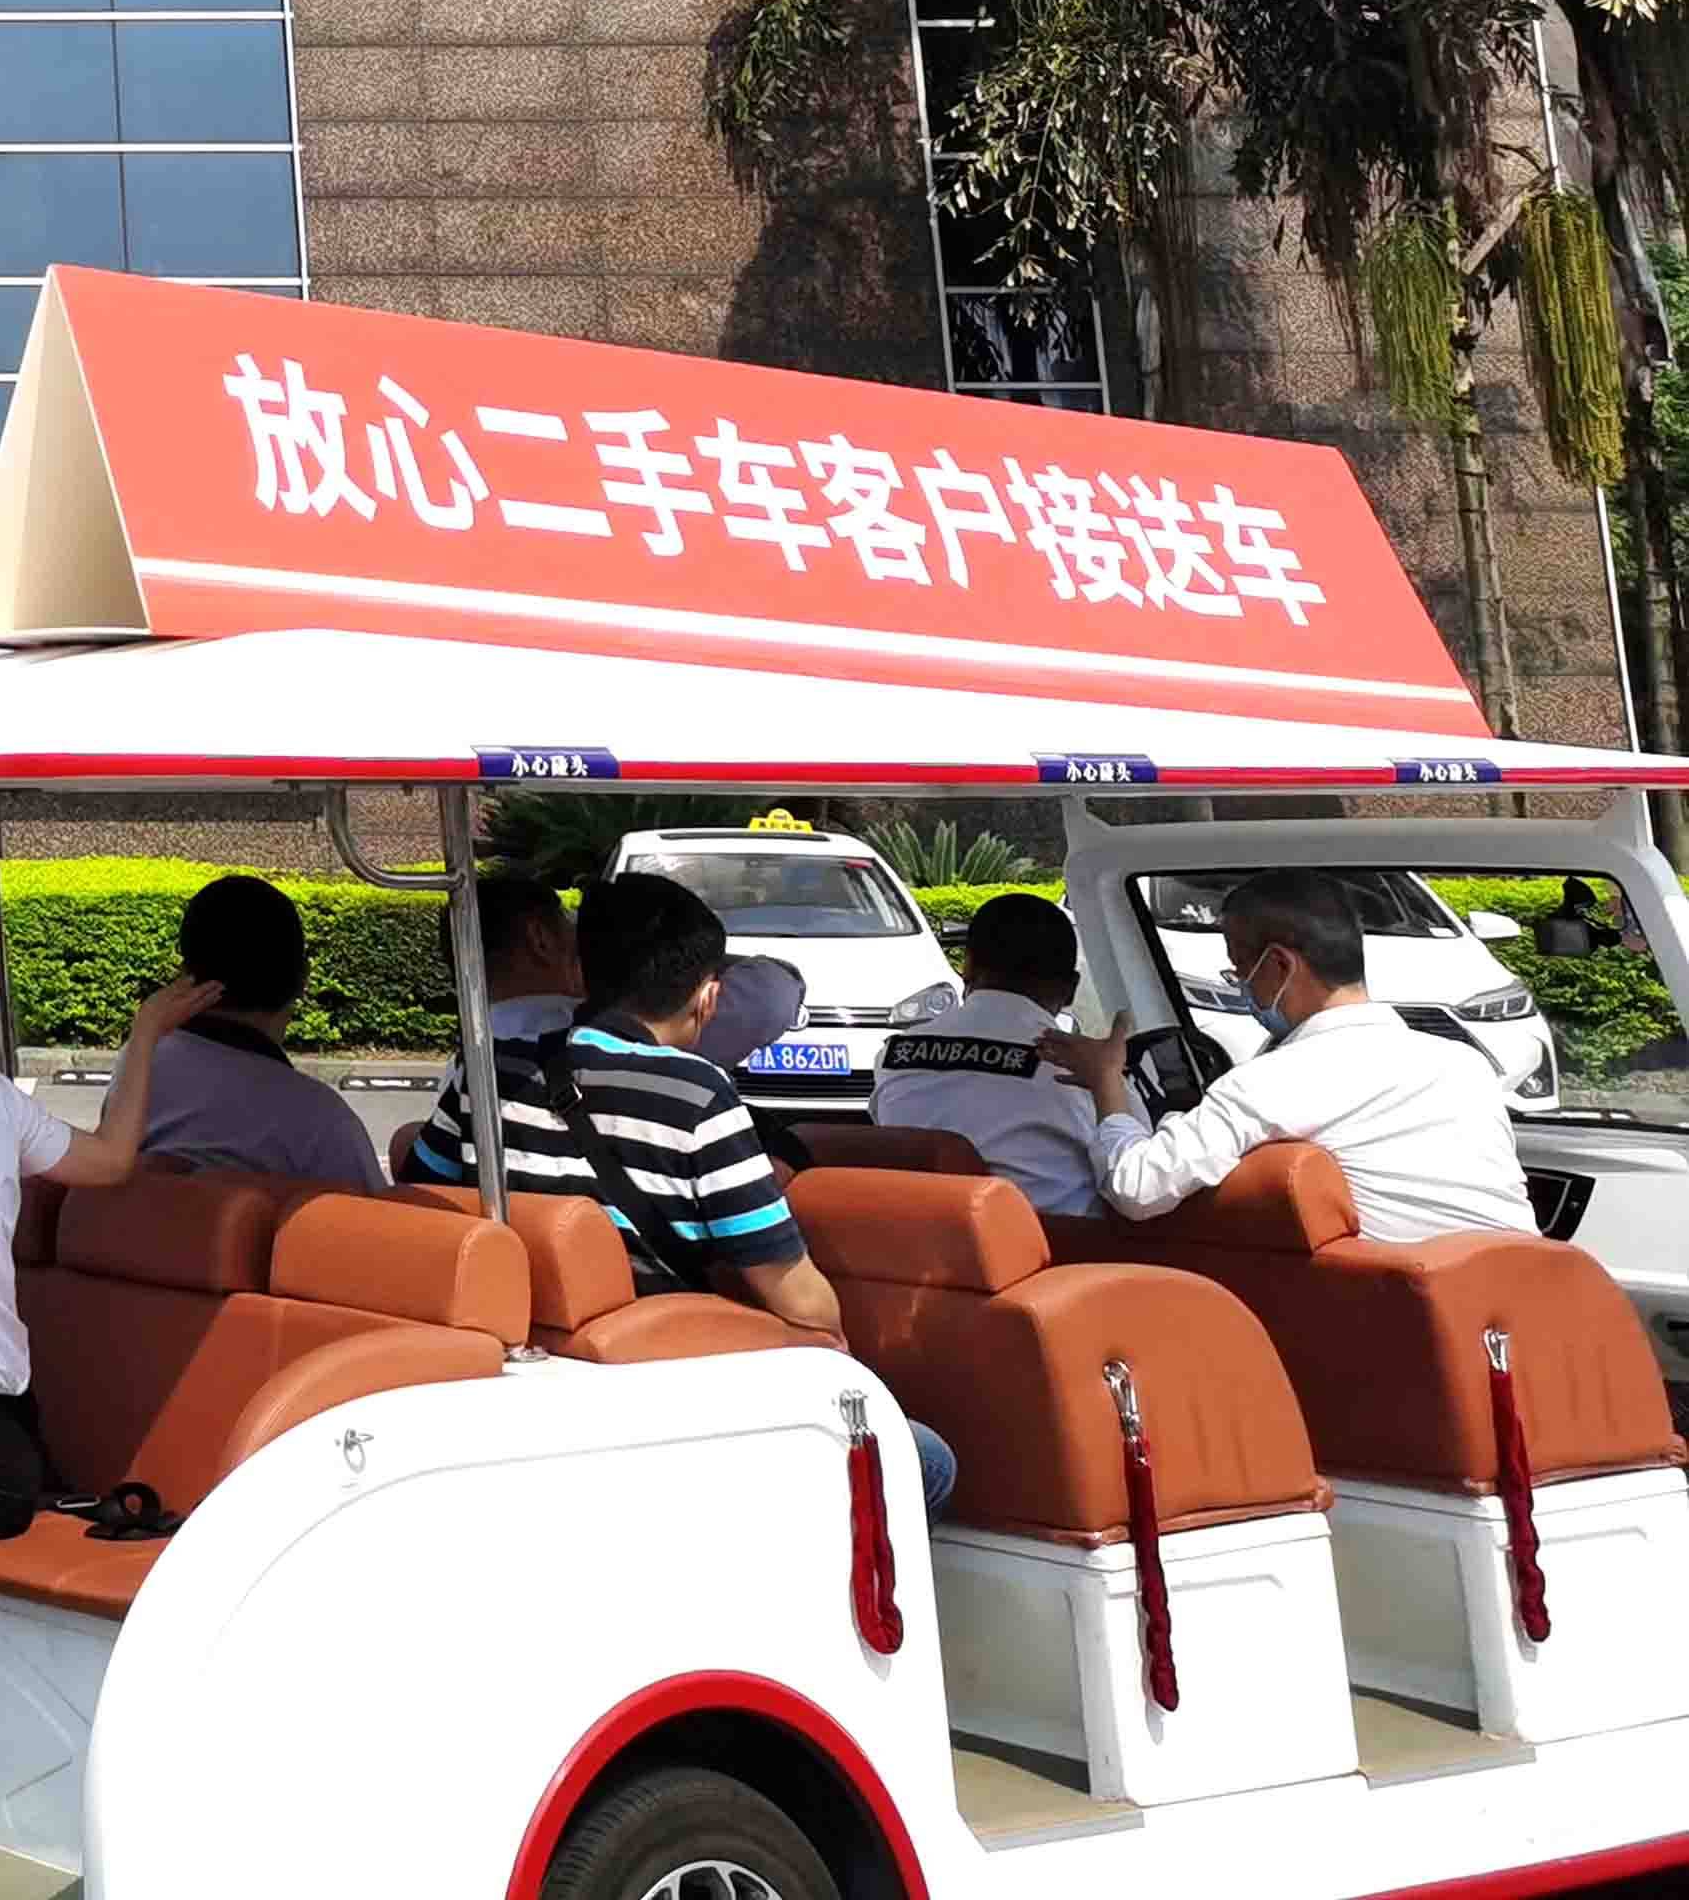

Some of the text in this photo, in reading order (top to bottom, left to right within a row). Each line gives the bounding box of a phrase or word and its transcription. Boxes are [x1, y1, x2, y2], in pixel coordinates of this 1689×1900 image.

[224, 353, 1327, 627] 放心二手车客户接送车
